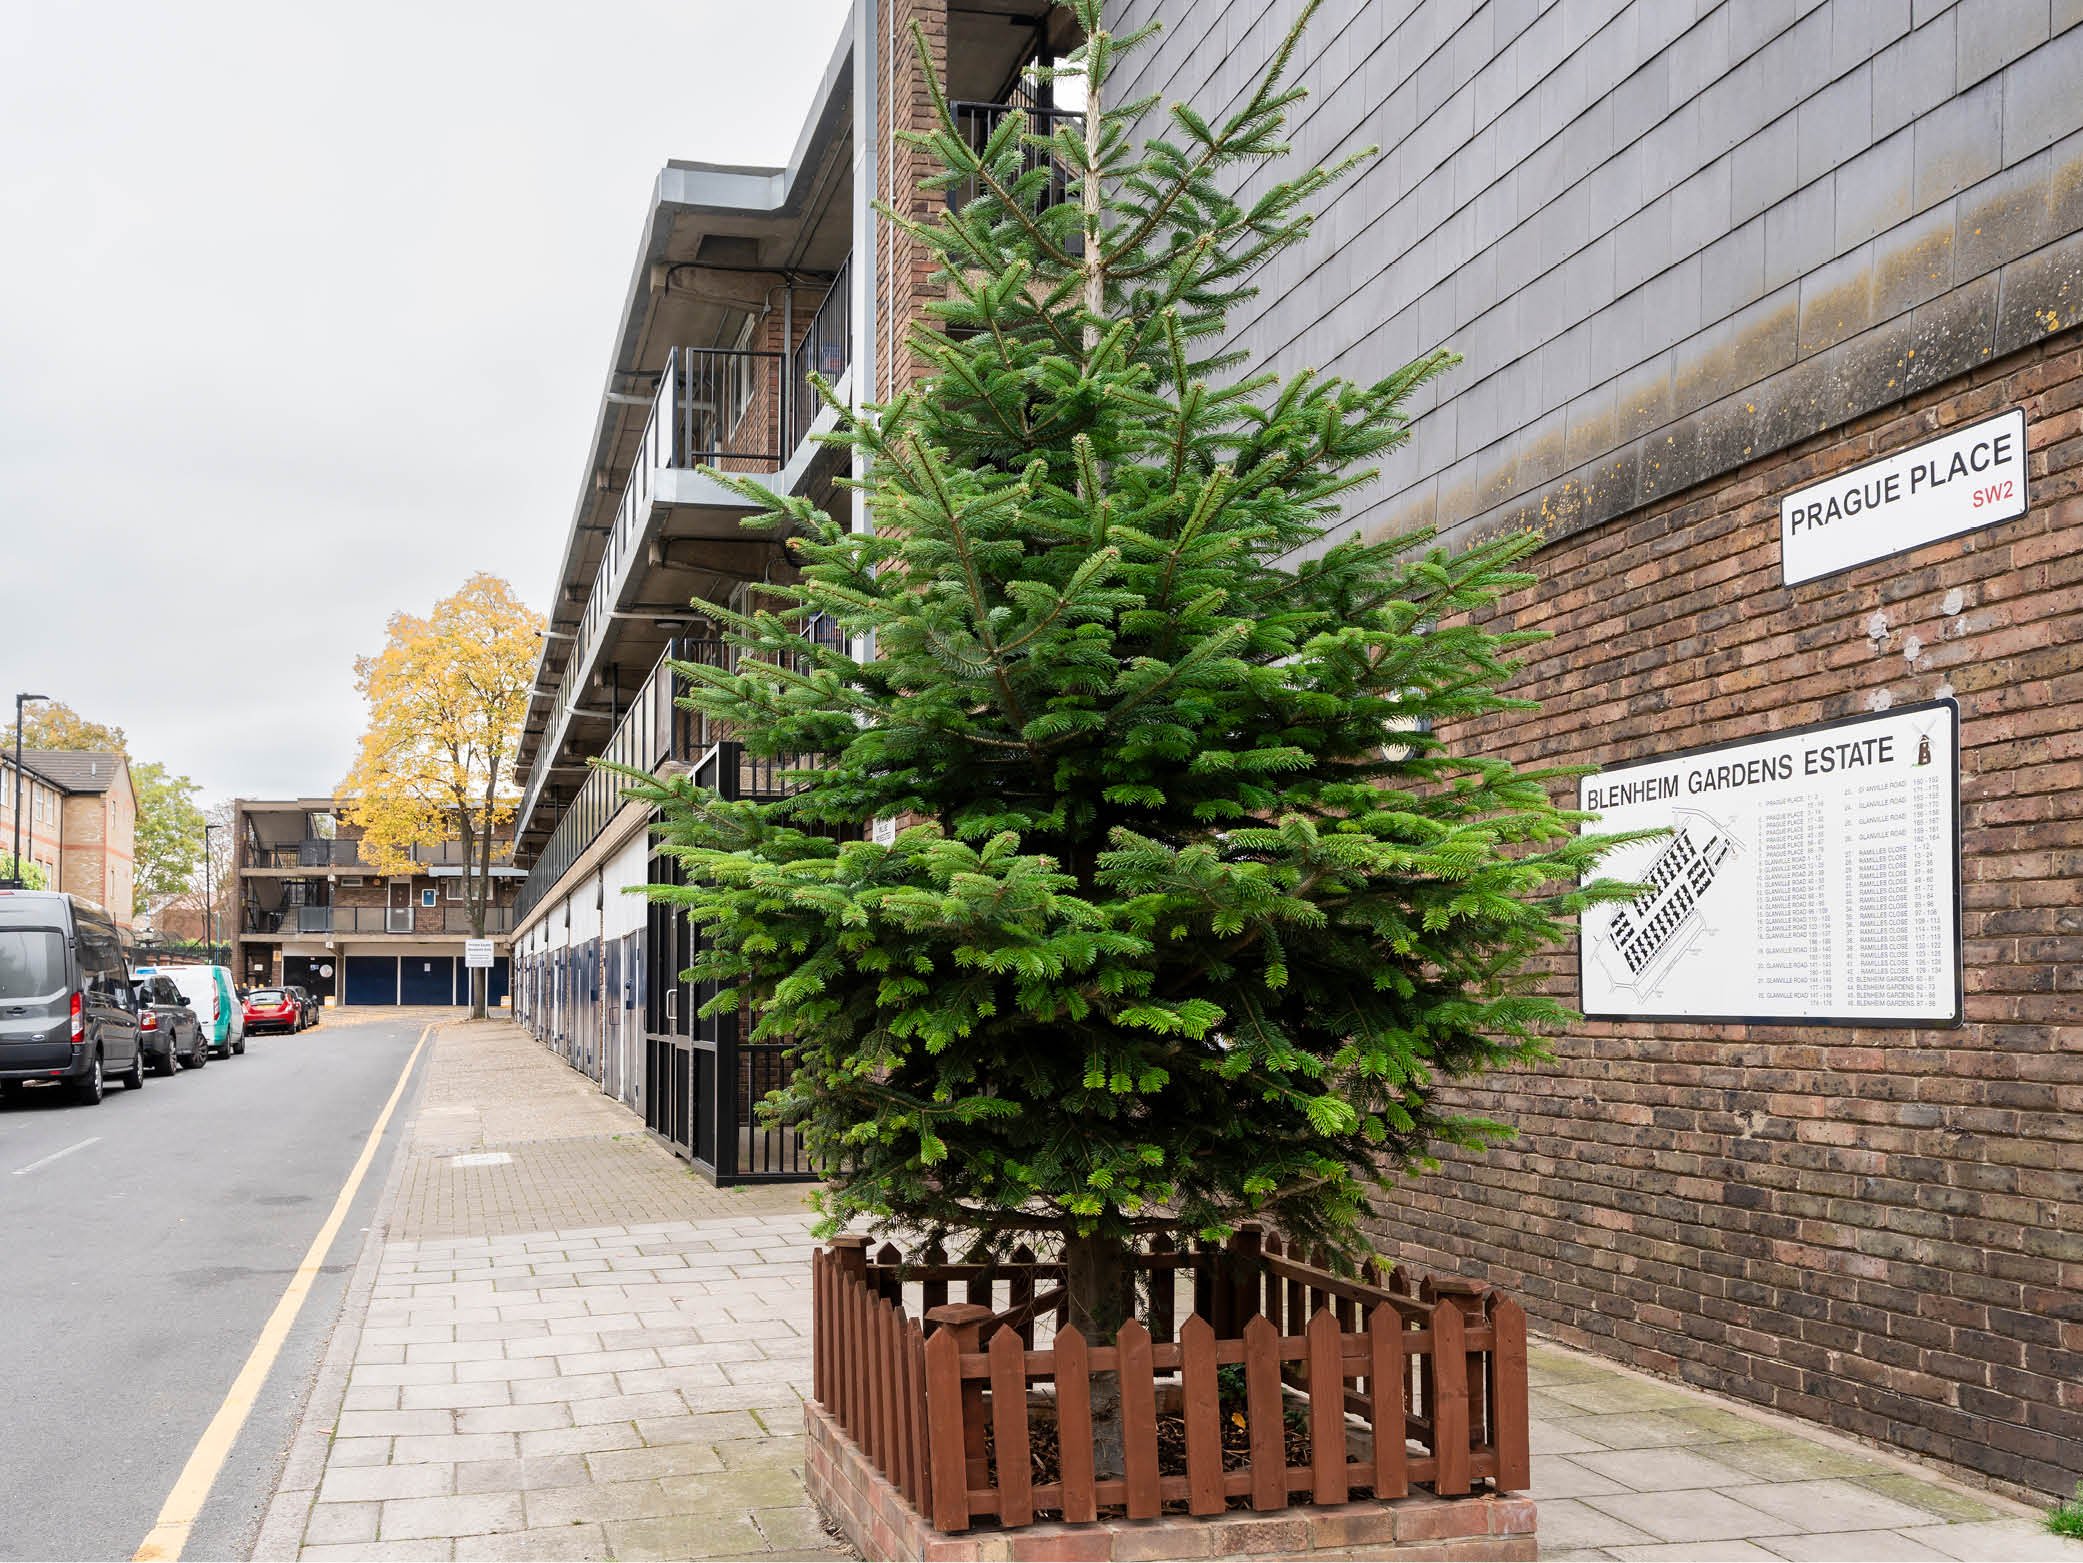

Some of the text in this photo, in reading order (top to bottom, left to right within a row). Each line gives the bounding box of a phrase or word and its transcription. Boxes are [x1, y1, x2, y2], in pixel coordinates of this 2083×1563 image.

[1791, 433, 2013, 536] PRAGUE PLACE
[1972, 480, 2014, 509] SW2
[1588, 735, 1894, 811] BLENHEIM GARDENS ESTATE
[1889, 780, 1905, 788] ROAD
[1766, 798, 1786, 806] PRAGUE
[1889, 796, 1905, 805] ROAD
[1766, 812, 1786, 821] PRAGUE
[1889, 813, 1905, 821] ROAD
[1766, 820, 1786, 828] PRAGUE
[1766, 828, 1786, 836] PRAGUE
[1887, 845, 1906, 853] CLOSE
